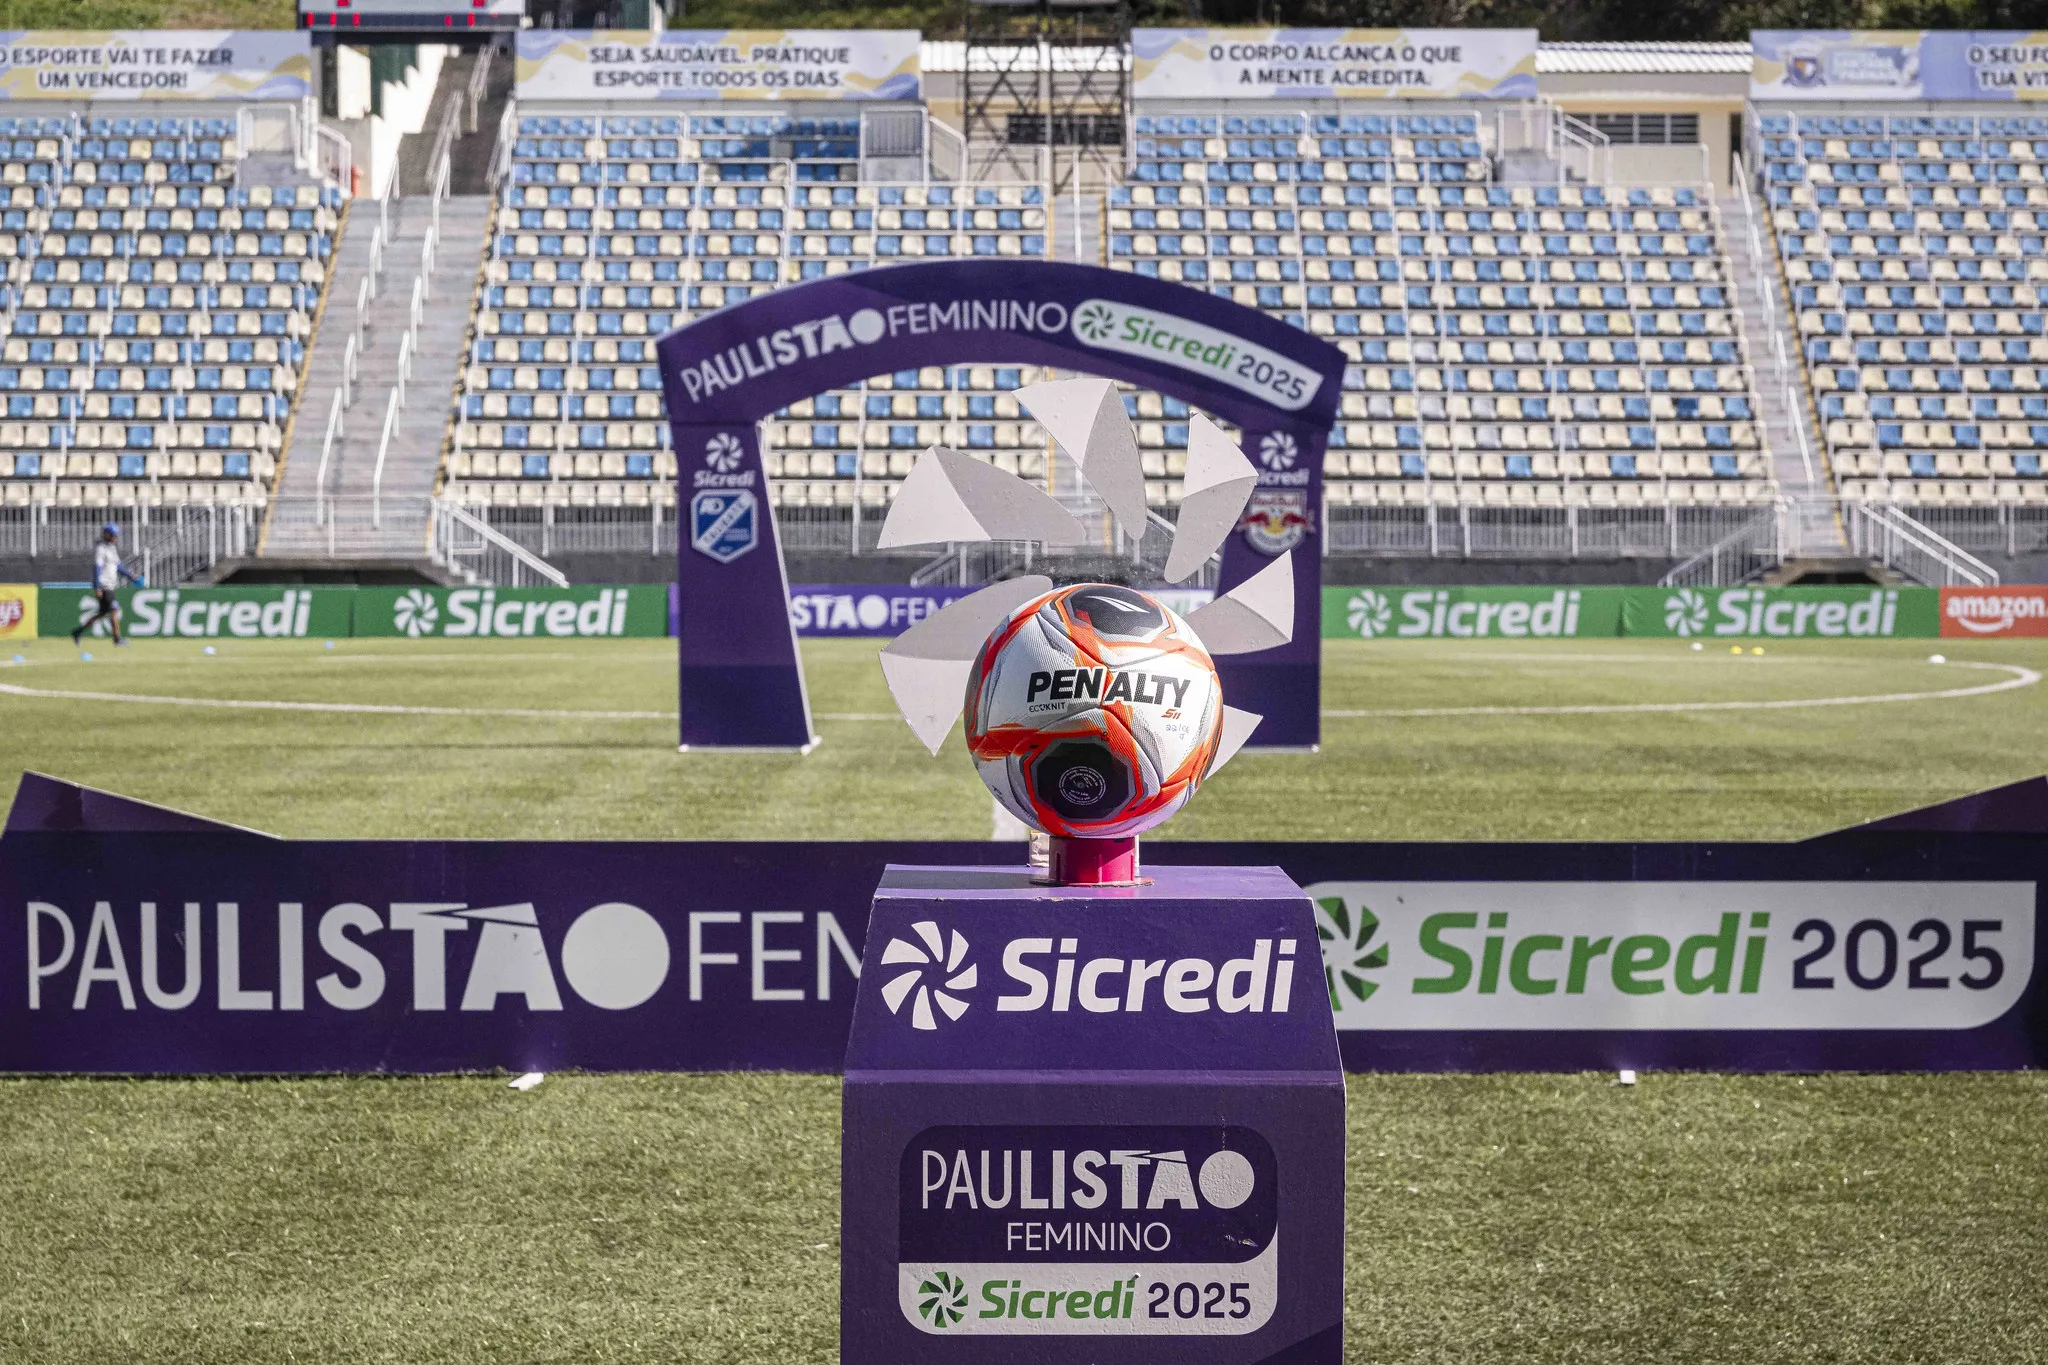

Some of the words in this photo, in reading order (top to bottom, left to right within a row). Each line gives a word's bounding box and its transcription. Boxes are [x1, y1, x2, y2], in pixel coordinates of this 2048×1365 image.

[13, 47, 102, 65] ESPORTE
[107, 47, 138, 65] VAI
[143, 47, 167, 65] TE
[172, 47, 233, 66] FAZER
[591, 47, 635, 63] SEJA
[752, 47, 850, 66] PRATIQUE
[1210, 45, 1224, 61] O
[1229, 45, 1299, 61] CORPO
[1304, 45, 1396, 64] ALCANÇA
[1402, 46, 1416, 62] O
[1421, 46, 1462, 65] QUE
[1970, 47, 1984, 63] O
[1989, 47, 2027, 63] SEU
[38, 71, 70, 88] UM
[76, 71, 188, 89] VENCEDOR!
[594, 71, 683, 87] ESPORTE
[691, 71, 757, 87] TODOS
[762, 71, 788, 87] OS
[1240, 69, 1252, 84] A
[1258, 69, 1325, 85] MENTE
[1332, 69, 1431, 86] ACREDITA.
[1981, 71, 2017, 87] TUA
[887, 299, 1068, 338] FEMININO
[1120, 315, 1236, 370] Sicredi
[1236, 354, 1308, 401] 2025
[128, 589, 313, 637] Sicredi
[444, 588, 629, 636] Sicredi
[1397, 590, 1581, 637] Sicredi
[1714, 590, 1898, 636] Sicredi
[1946, 595, 2045, 619] amazon
[1026, 667, 1191, 708] PENALTY
[1411, 911, 1771, 995] Sicredi
[1792, 919, 2005, 990] 2025
[996, 938, 1298, 1014] Sicredi
[1006, 1221, 1172, 1252] FEMININO
[978, 1279, 1138, 1319] Sicredi
[1147, 1282, 1252, 1319] 2025
